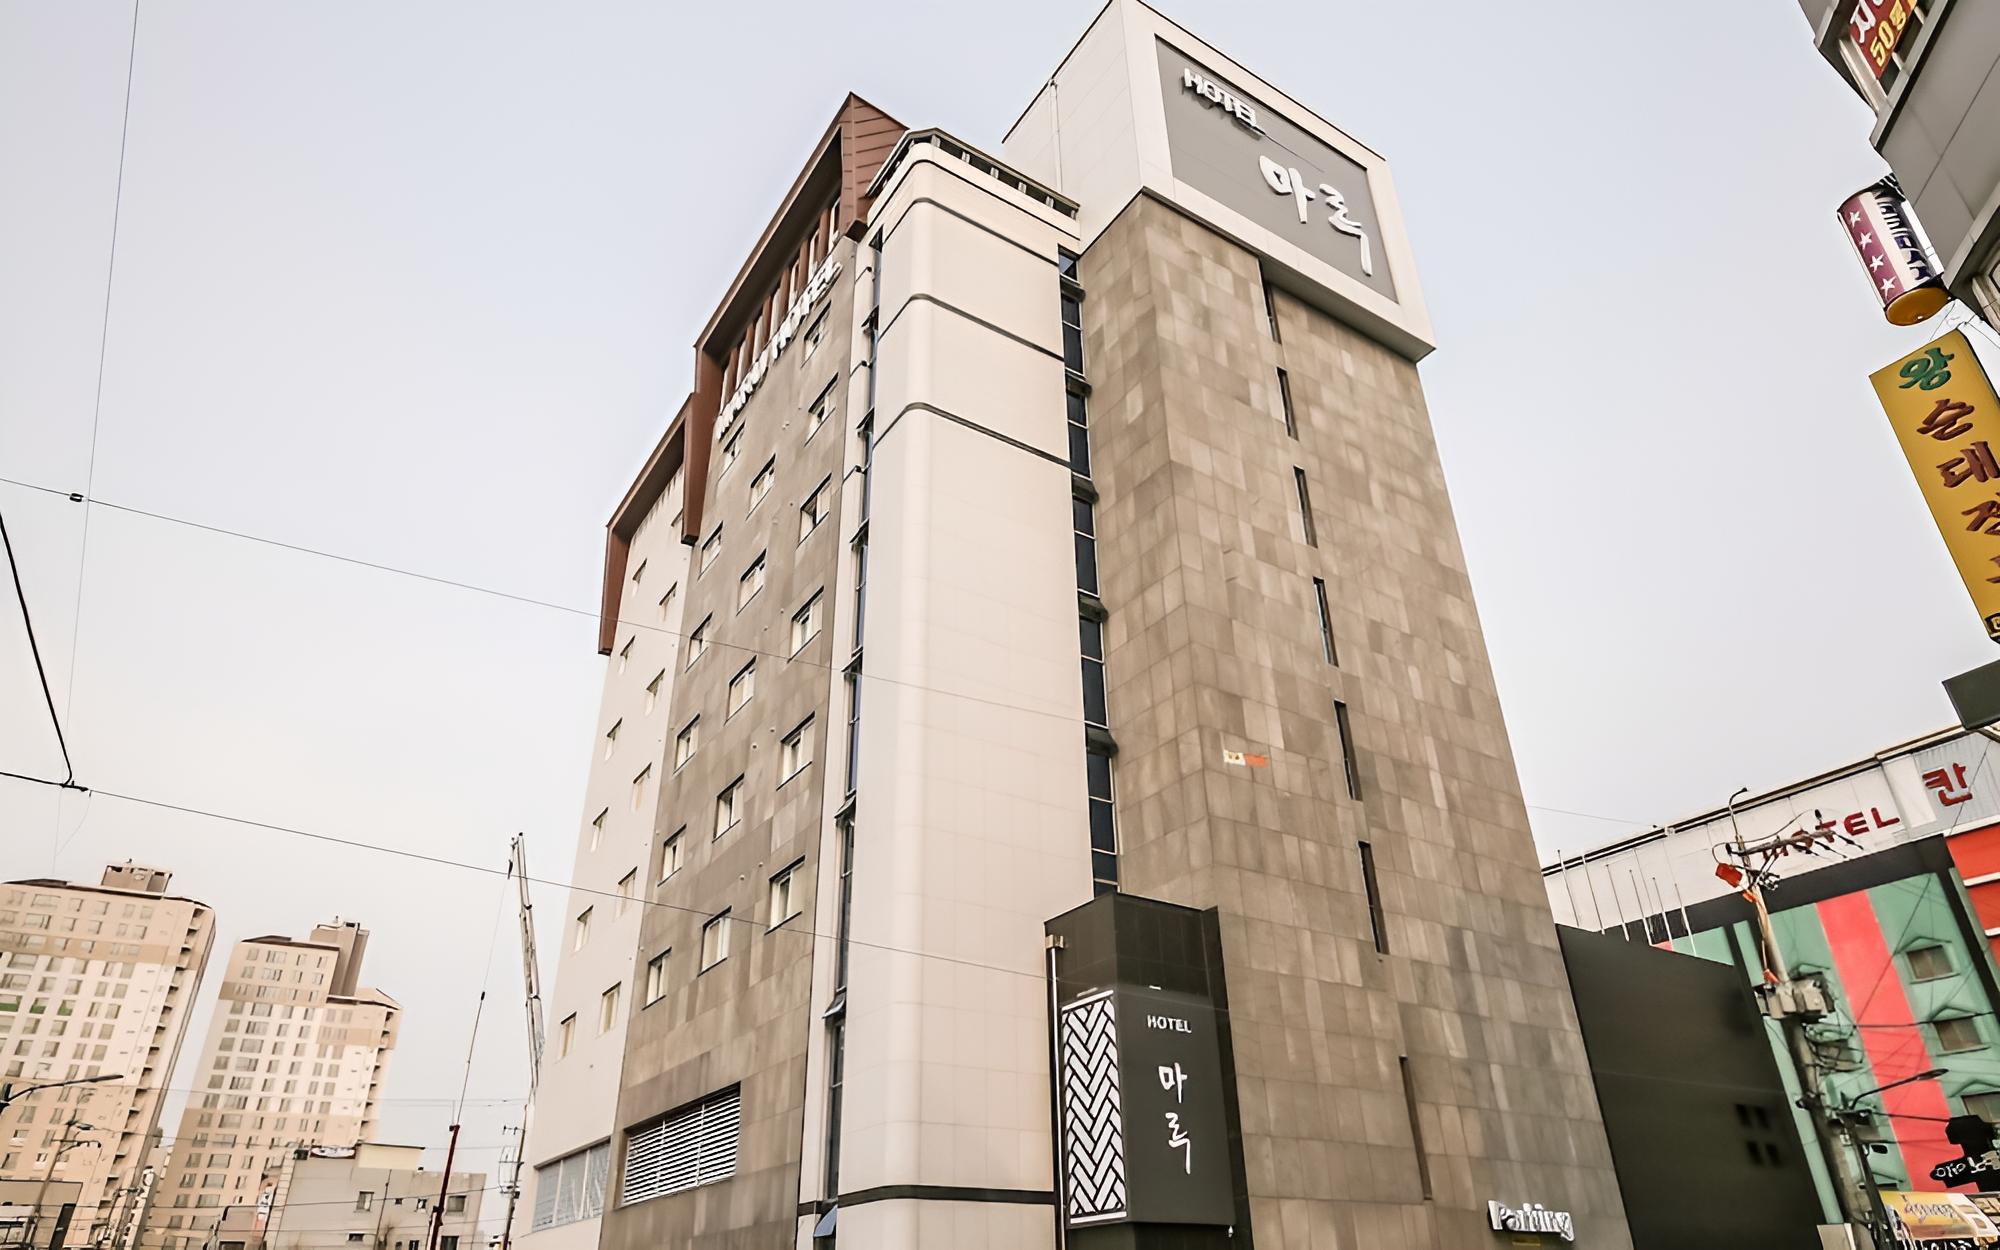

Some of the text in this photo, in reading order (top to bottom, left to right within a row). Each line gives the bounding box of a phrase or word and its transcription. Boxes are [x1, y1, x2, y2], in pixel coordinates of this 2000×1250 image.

[1182, 67, 1265, 136] HOTEL
[1921, 762, 1974, 807] 칸
[1146, 1014, 1193, 1034] HOTEL
[1487, 1199, 1576, 1242] Parking
